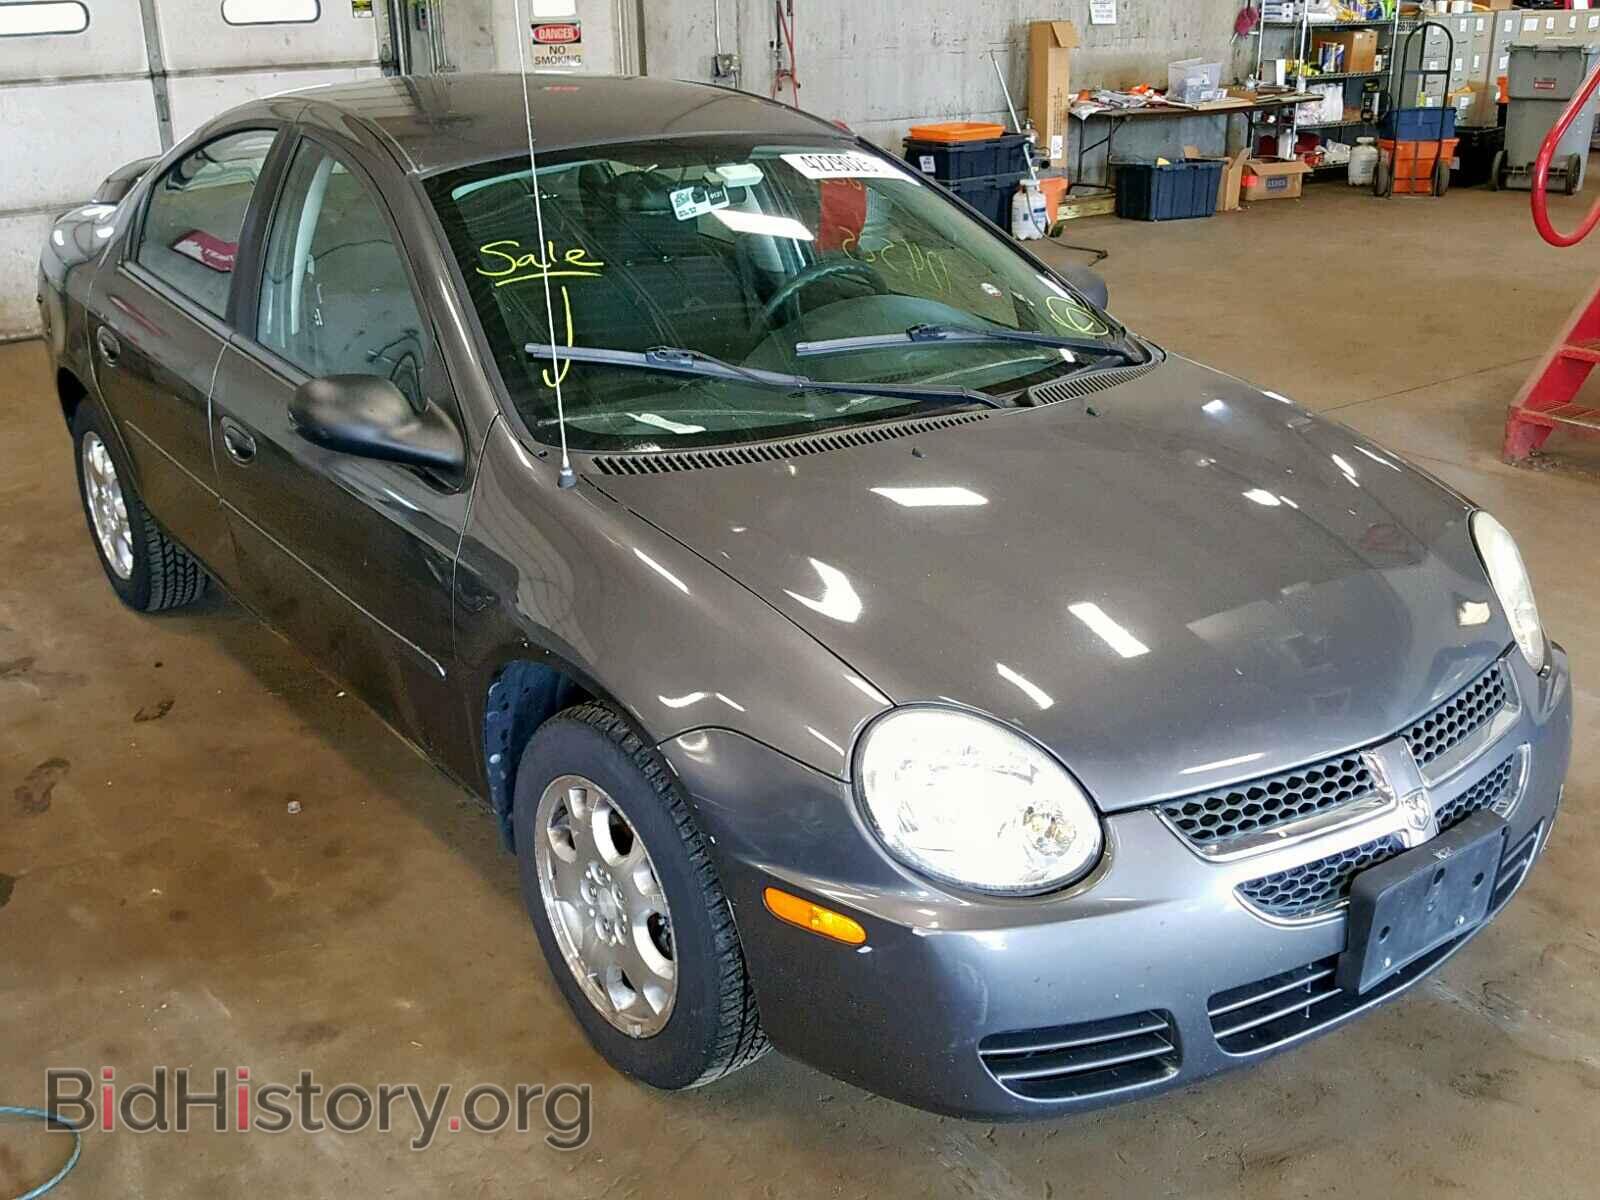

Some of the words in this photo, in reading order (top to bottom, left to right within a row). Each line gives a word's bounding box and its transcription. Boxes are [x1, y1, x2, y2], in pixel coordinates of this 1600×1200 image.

[538, 26, 575, 40] DANGER
[549, 45, 566, 55] NO
[534, 54, 582, 65] SMOKING
[476, 240, 604, 277] Sale
